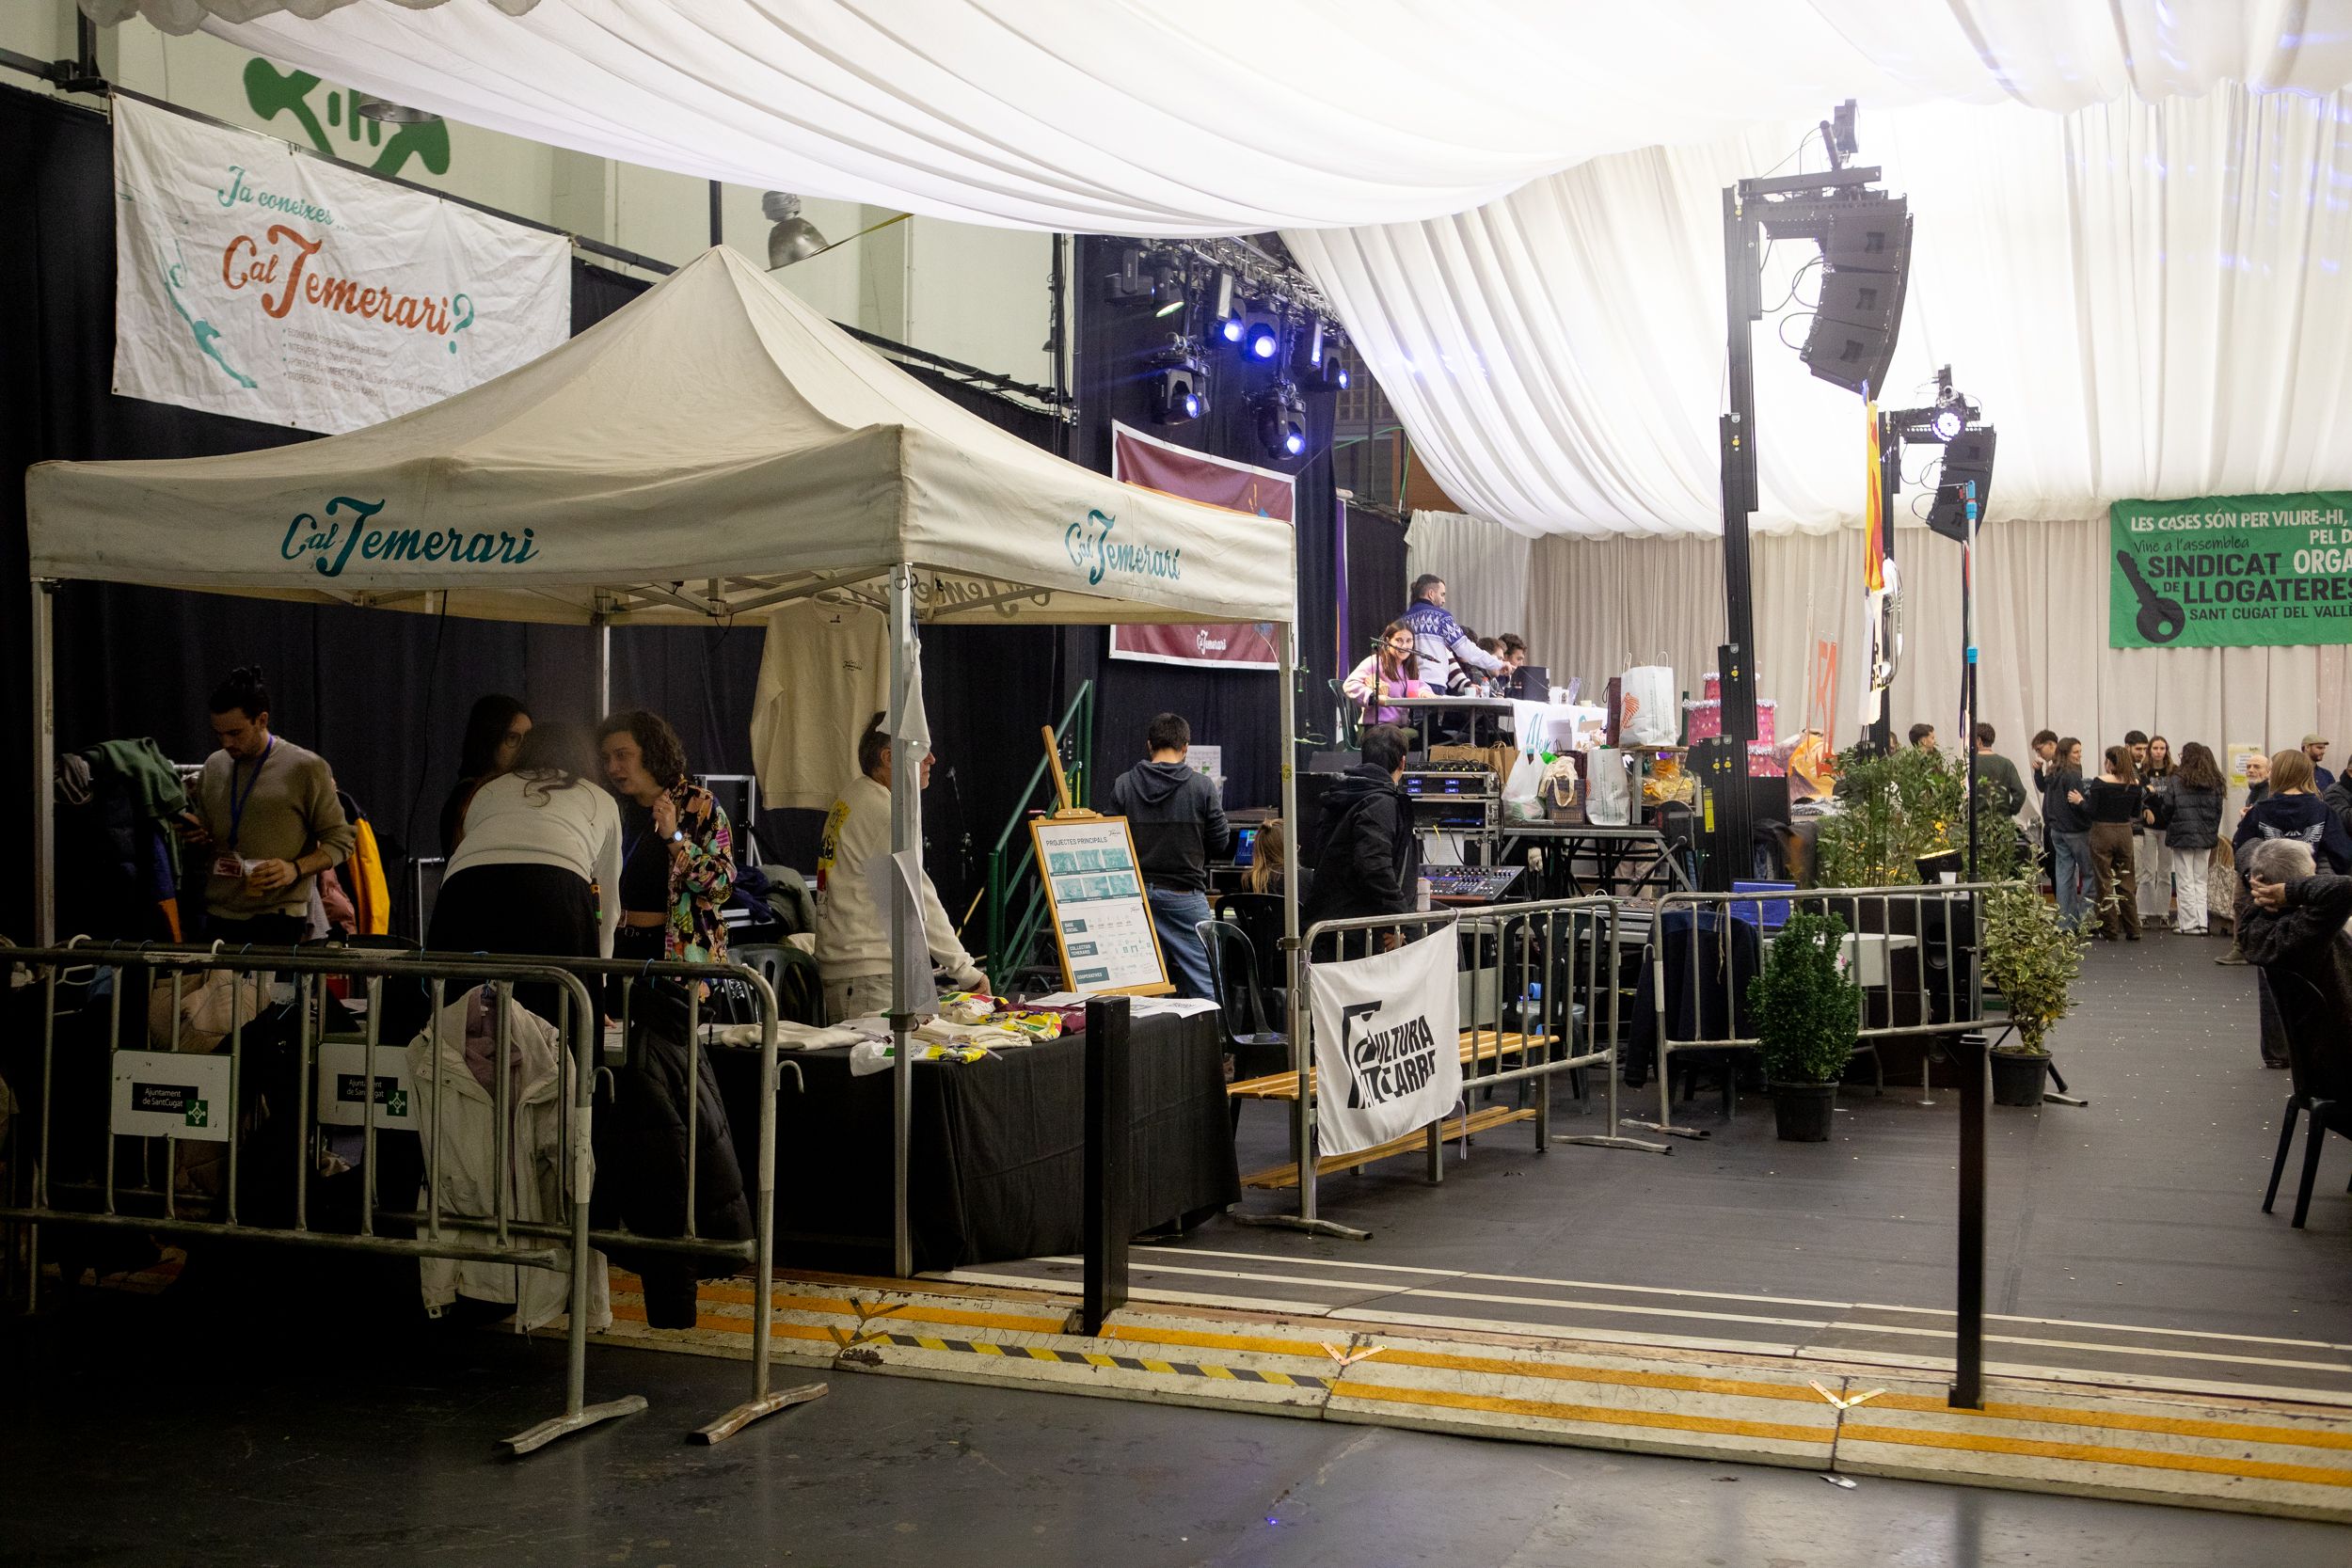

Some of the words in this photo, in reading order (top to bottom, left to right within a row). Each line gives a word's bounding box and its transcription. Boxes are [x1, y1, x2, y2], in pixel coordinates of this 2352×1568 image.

[217, 166, 253, 207] Ja
[223, 234, 278, 291] Cal
[2131, 516, 2154, 532] LES
[2158, 514, 2201, 531] CASES
[2204, 508, 2236, 529] SÓN
[2241, 512, 2269, 528] PER
[2271, 509, 2348, 528] VIURE-HI,
[281, 513, 340, 561] Cal
[315, 496, 540, 578] Temerari
[1065, 522, 1094, 568] Cal
[1088, 509, 1181, 586] Temerari
[2134, 541, 2160, 553] Vine
[2164, 543, 2172, 552] a
[2176, 535, 2249, 552] l'assemblea
[2310, 530, 2337, 545] PEL
[2148, 553, 2281, 578] SINDICAT
[2294, 548, 2352, 574] ORGA
[2164, 581, 2180, 593] DE
[2189, 608, 2226, 621] SANT
[2232, 607, 2279, 620] CUGAT
[2283, 606, 2309, 618] DEL
[1046, 838, 1077, 847] PROJECTES
[1077, 836, 1108, 845] PRINCIPALS
[1354, 1015, 1435, 1069] CULTURA
[145, 1087, 182, 1098] Ajuntament
